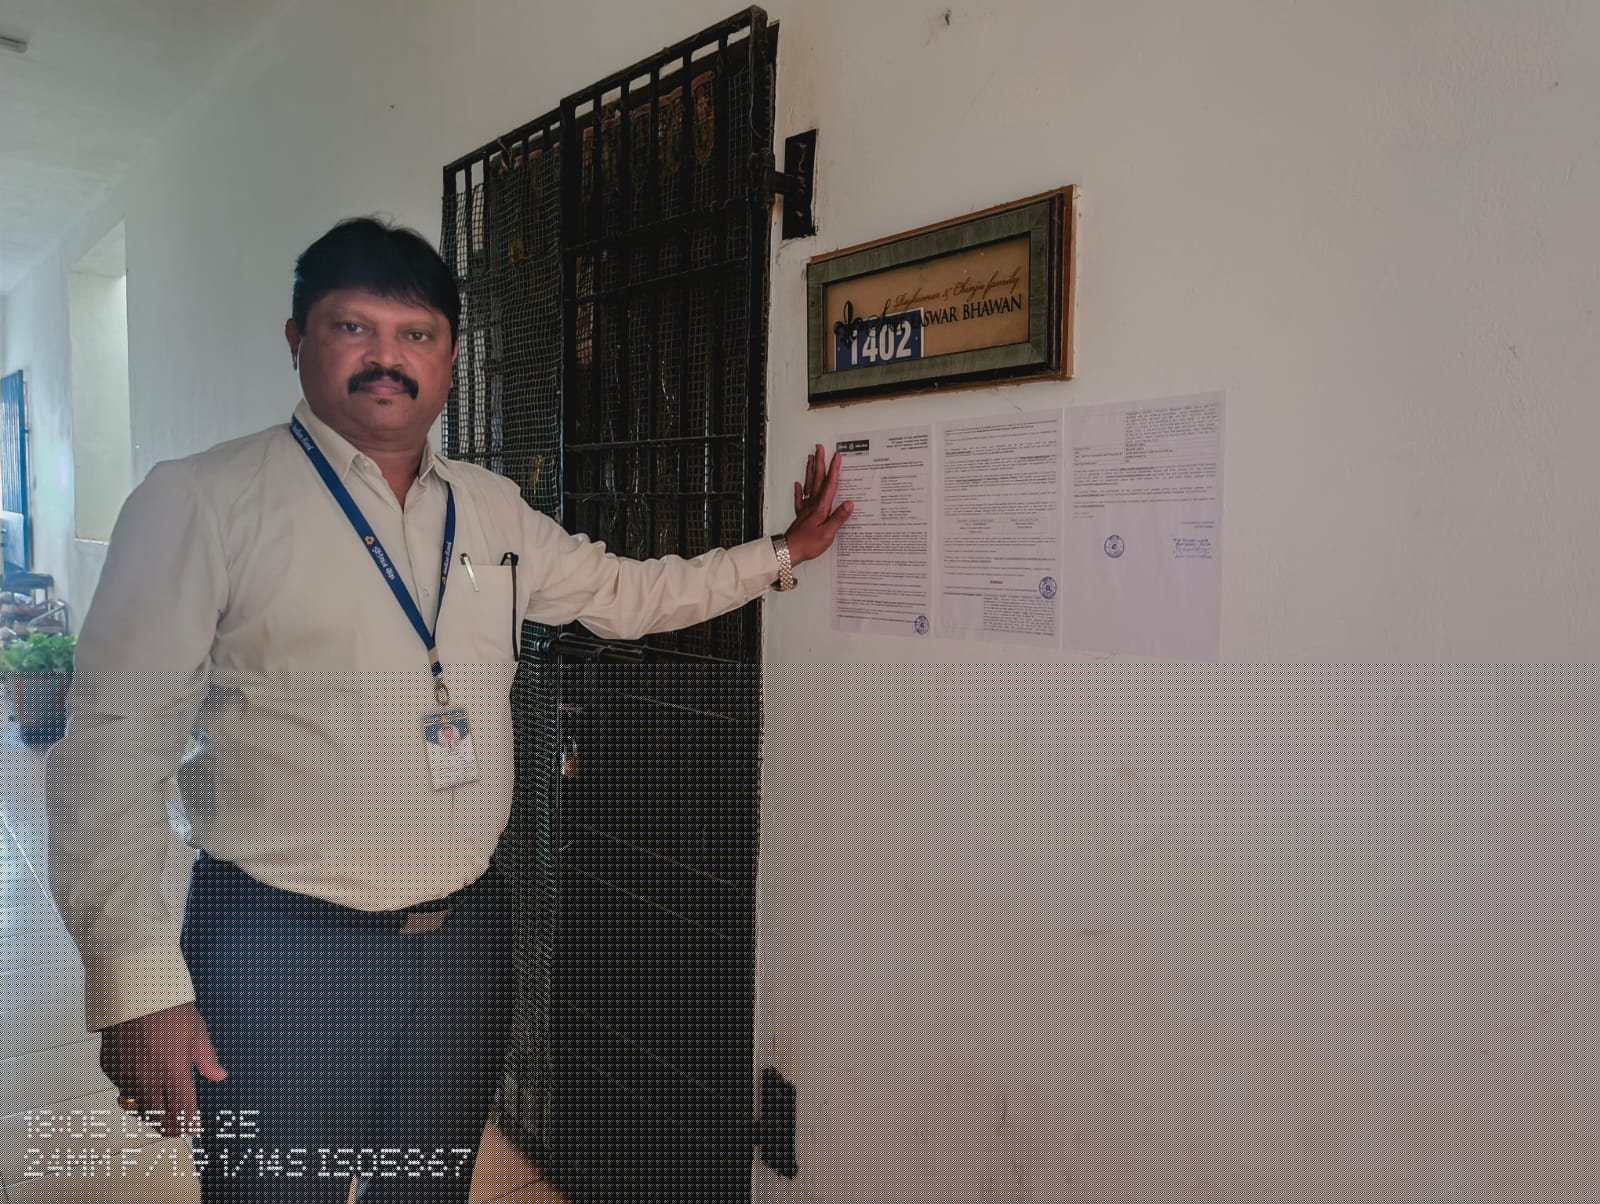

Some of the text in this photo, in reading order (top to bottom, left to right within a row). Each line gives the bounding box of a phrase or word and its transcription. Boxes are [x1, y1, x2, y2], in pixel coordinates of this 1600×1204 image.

[982, 265, 1022, 299] family
[962, 292, 1023, 321] BHAWAN
[851, 320, 913, 366] 1402
